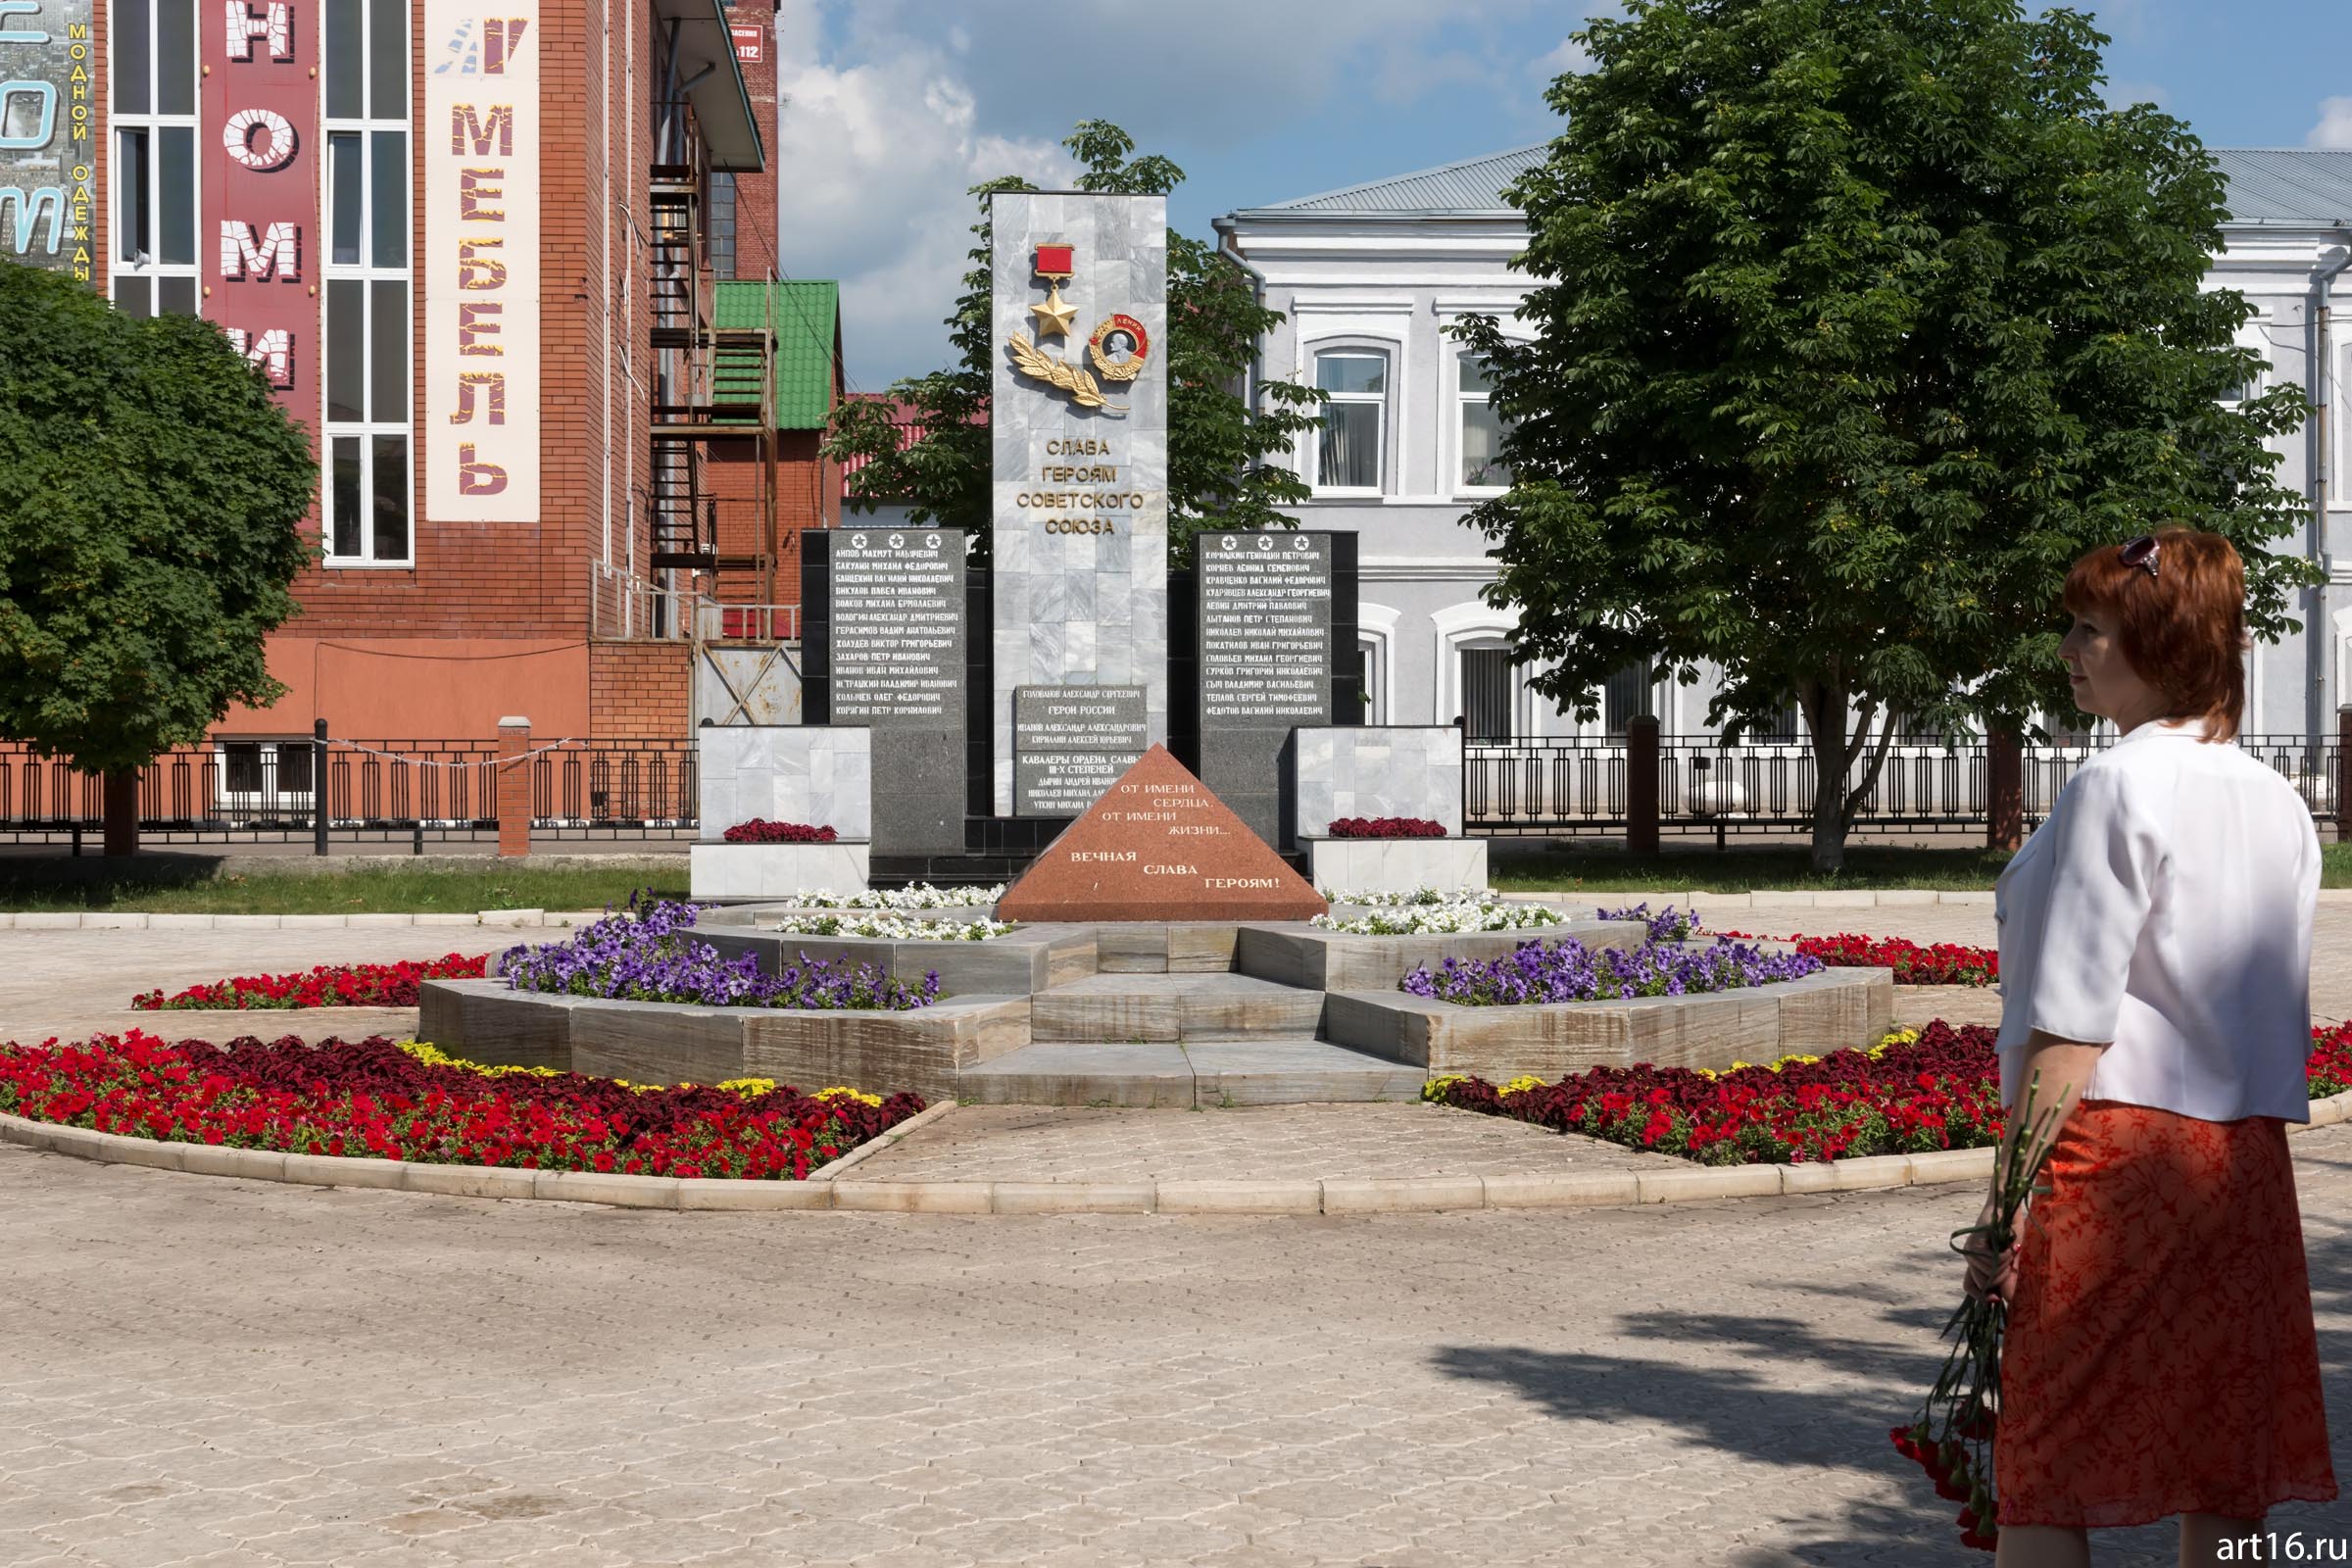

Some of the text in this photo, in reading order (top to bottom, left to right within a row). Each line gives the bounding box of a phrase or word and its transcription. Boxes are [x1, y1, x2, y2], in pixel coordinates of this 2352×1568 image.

[739, 45, 760, 58] 112
[69, 24, 89, 281] МОДНОЙ ОДЕЖДЫ
[450, 103, 513, 496] МЕБЕЛЬ
[1047, 439, 1110, 456] СЛАВА
[1042, 466, 1117, 483] ГЕРОЯМ
[1016, 493, 1144, 509] СОВЕТСКОГО
[1046, 518, 1115, 535] СОЮЗА
[1250, 574, 1282, 584] ВАСИЛИЙ
[1237, 692, 1266, 702] СЕРГЕЙ
[1242, 705, 1274, 714] ВАСИЛИЙ
[1068, 734, 1098, 743] АЛЕКСЕЙ
[1022, 756, 1069, 764] КАВАЛЕРЫ
[1073, 756, 1106, 764] ОРДЕНА
[1067, 763, 1113, 774] СТЕПЕНЕЙ
[1064, 776, 1090, 786] АНДРЕЙ
[1120, 785, 1195, 794] ОТ ИМЕНИ
[1102, 812, 1176, 821] ОТ ИМЕНИ
[1071, 852, 1137, 862] ВЕЧНАЯ
[1144, 864, 1198, 875] СЛАВА
[1204, 878, 1280, 889] ГЕРОЯМ!
